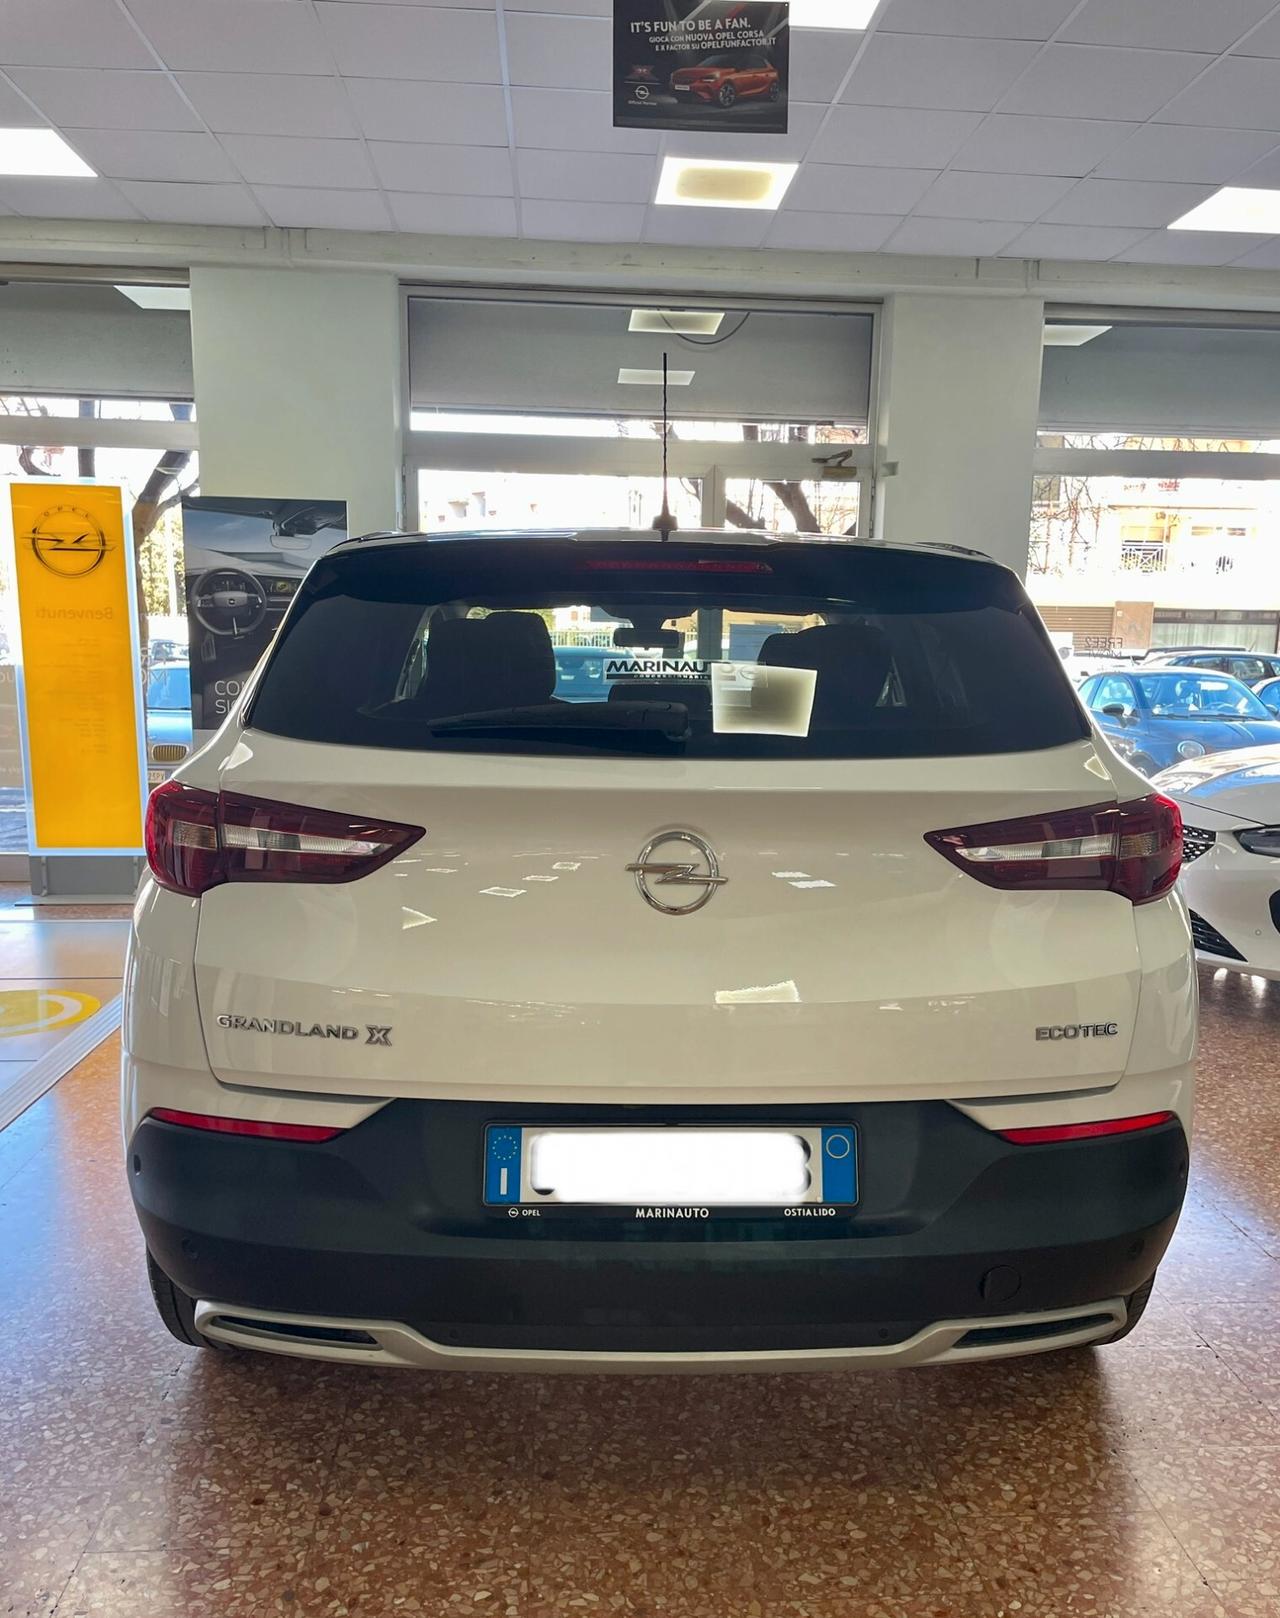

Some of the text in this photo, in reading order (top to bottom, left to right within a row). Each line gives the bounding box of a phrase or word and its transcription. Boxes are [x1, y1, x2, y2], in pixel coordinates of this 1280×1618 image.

[631, 17, 751, 33] IT'S FUN TO BE A FAN.
[649, 30, 764, 43] GIOCA CON NUOVA OPEL CORSA
[691, 42, 700, 50] SU
[214, 680, 245, 696] CO
[215, 699, 236, 714] SI
[217, 1014, 392, 1046] GRANDLAND X
[1035, 1023, 1118, 1041] ECOTEC
[522, 1209, 541, 1218] OPEL
[635, 1207, 710, 1219] MARINAUTO
[784, 1208, 836, 1217] OSTIA LIDO
